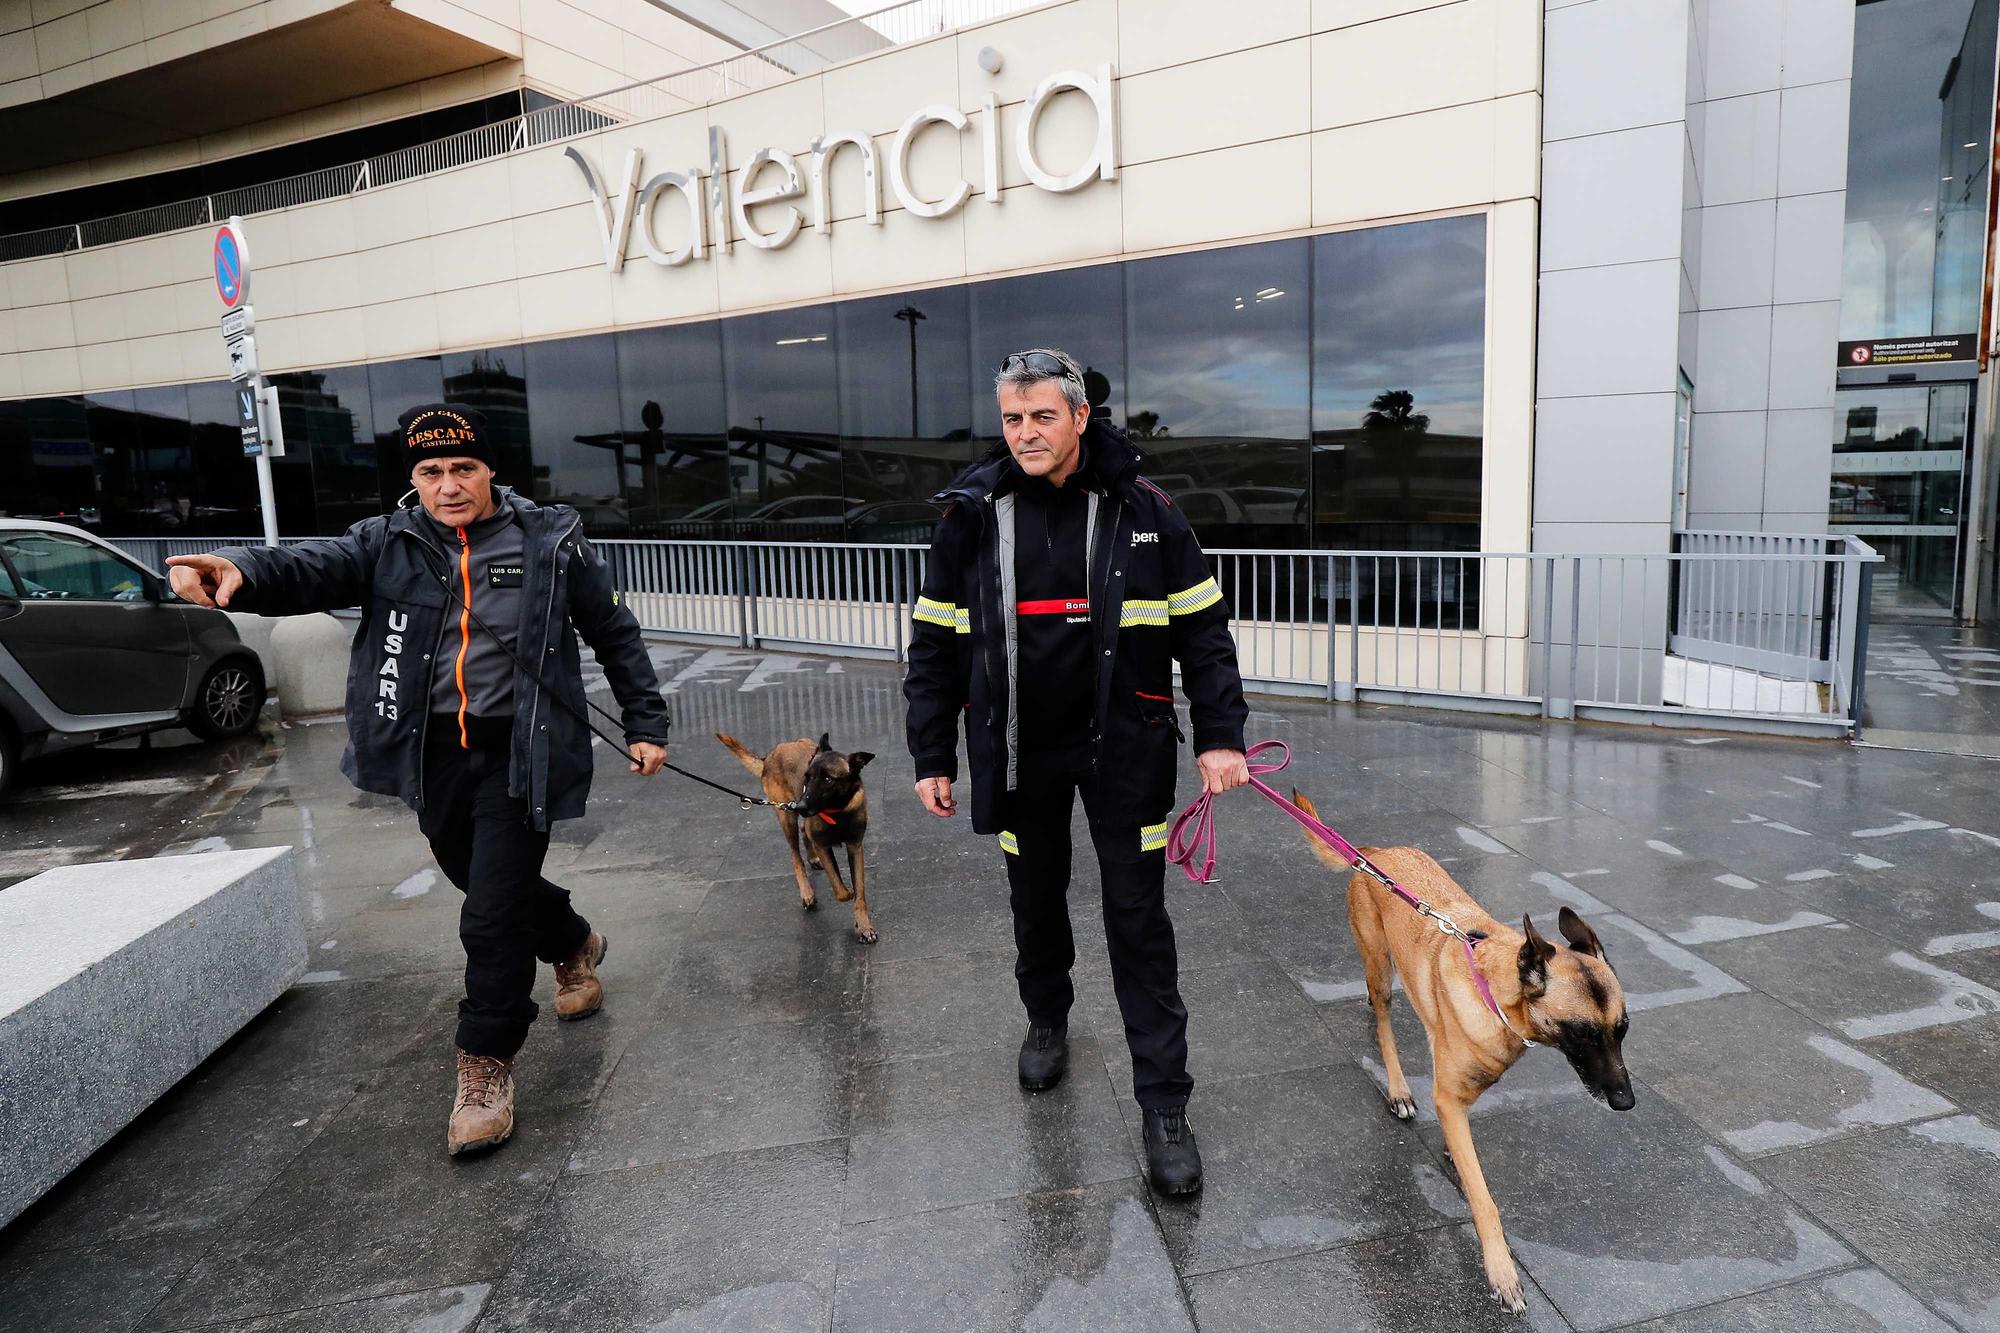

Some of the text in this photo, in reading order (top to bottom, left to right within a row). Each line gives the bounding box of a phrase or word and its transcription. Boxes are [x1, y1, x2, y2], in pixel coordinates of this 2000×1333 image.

[564, 45, 1120, 274] Valencia
[1897, 342, 1925, 350] personal
[1926, 340, 1959, 348] autoritzat
[1888, 354, 1916, 362] personal
[1917, 352, 1953, 360] autorizado
[406, 411, 435, 436] UNIDAD
[408, 427, 476, 448] RESCATE
[374, 609, 408, 721] USAR 13
